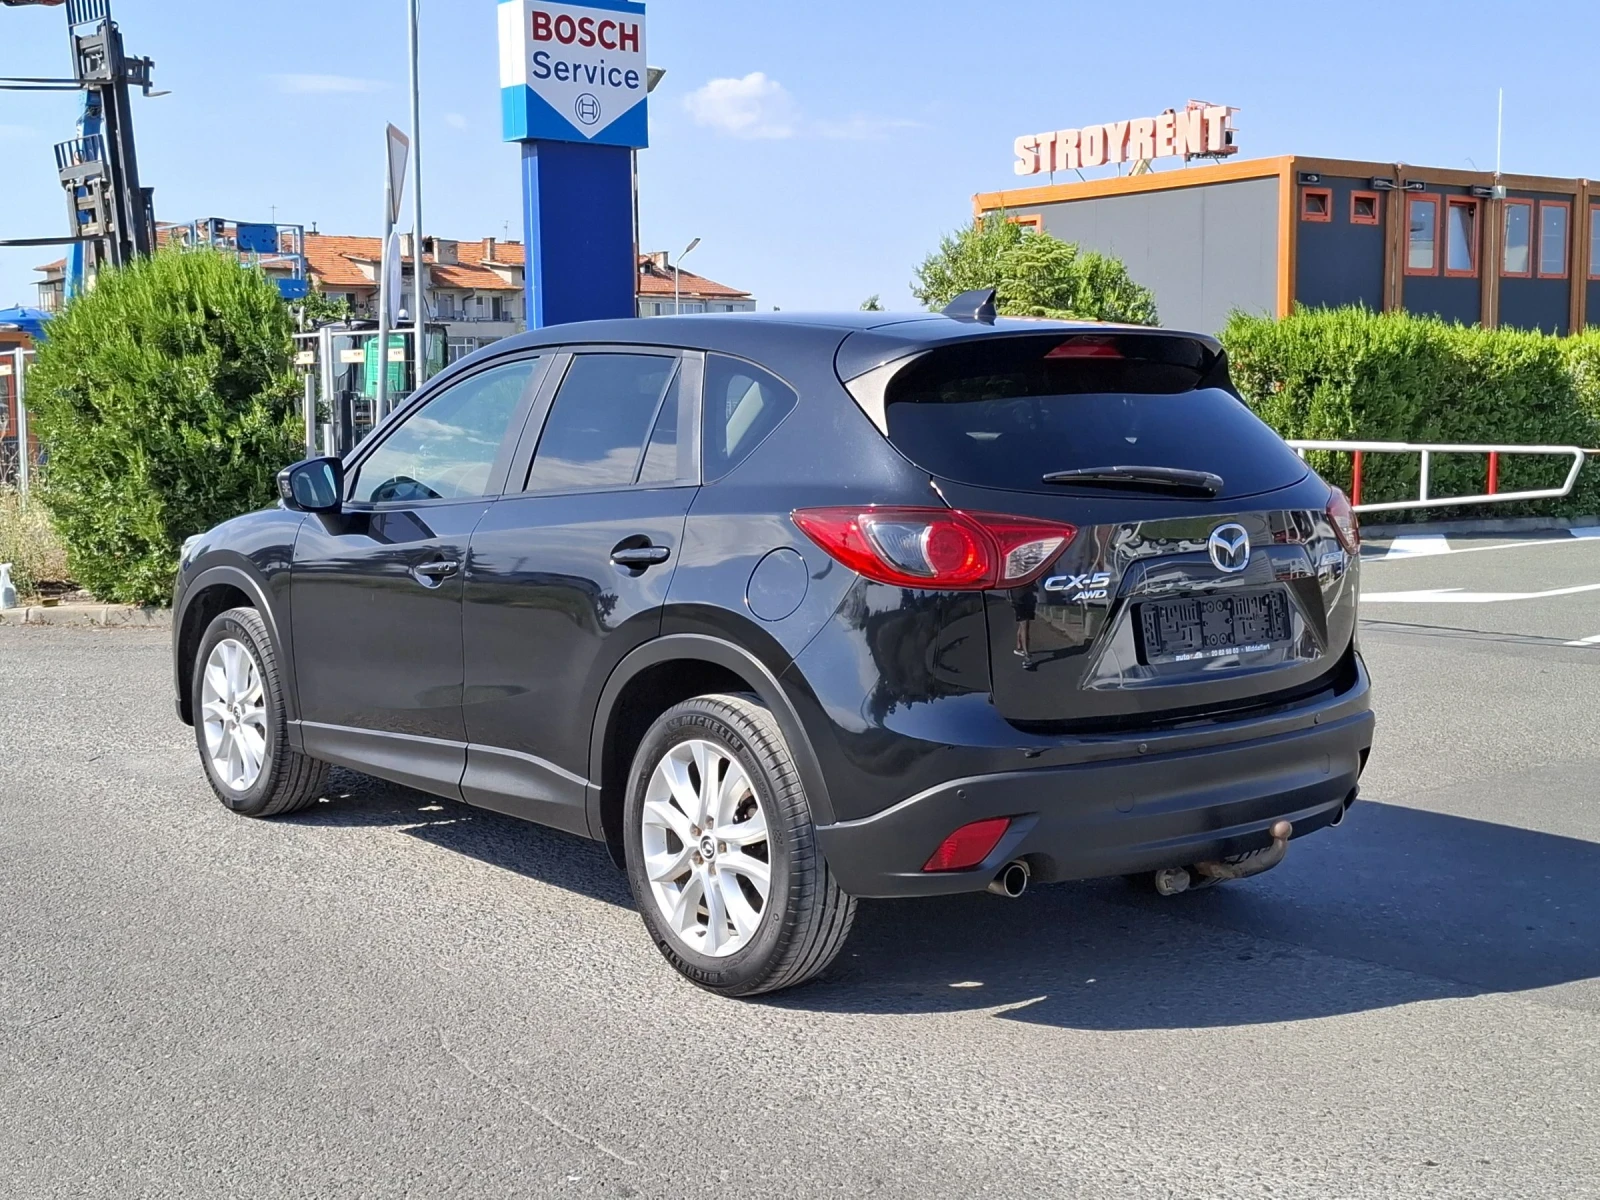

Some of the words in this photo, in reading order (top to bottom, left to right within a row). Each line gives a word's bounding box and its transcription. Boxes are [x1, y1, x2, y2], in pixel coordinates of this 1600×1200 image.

[532, 11, 639, 52] BOSCH
[532, 51, 640, 89] Service
[1014, 106, 1229, 175] STROYRENT
[1044, 572, 1111, 591] CX-5
[1071, 589, 1108, 601] AWD
[681, 716, 742, 750] MICHELIN
